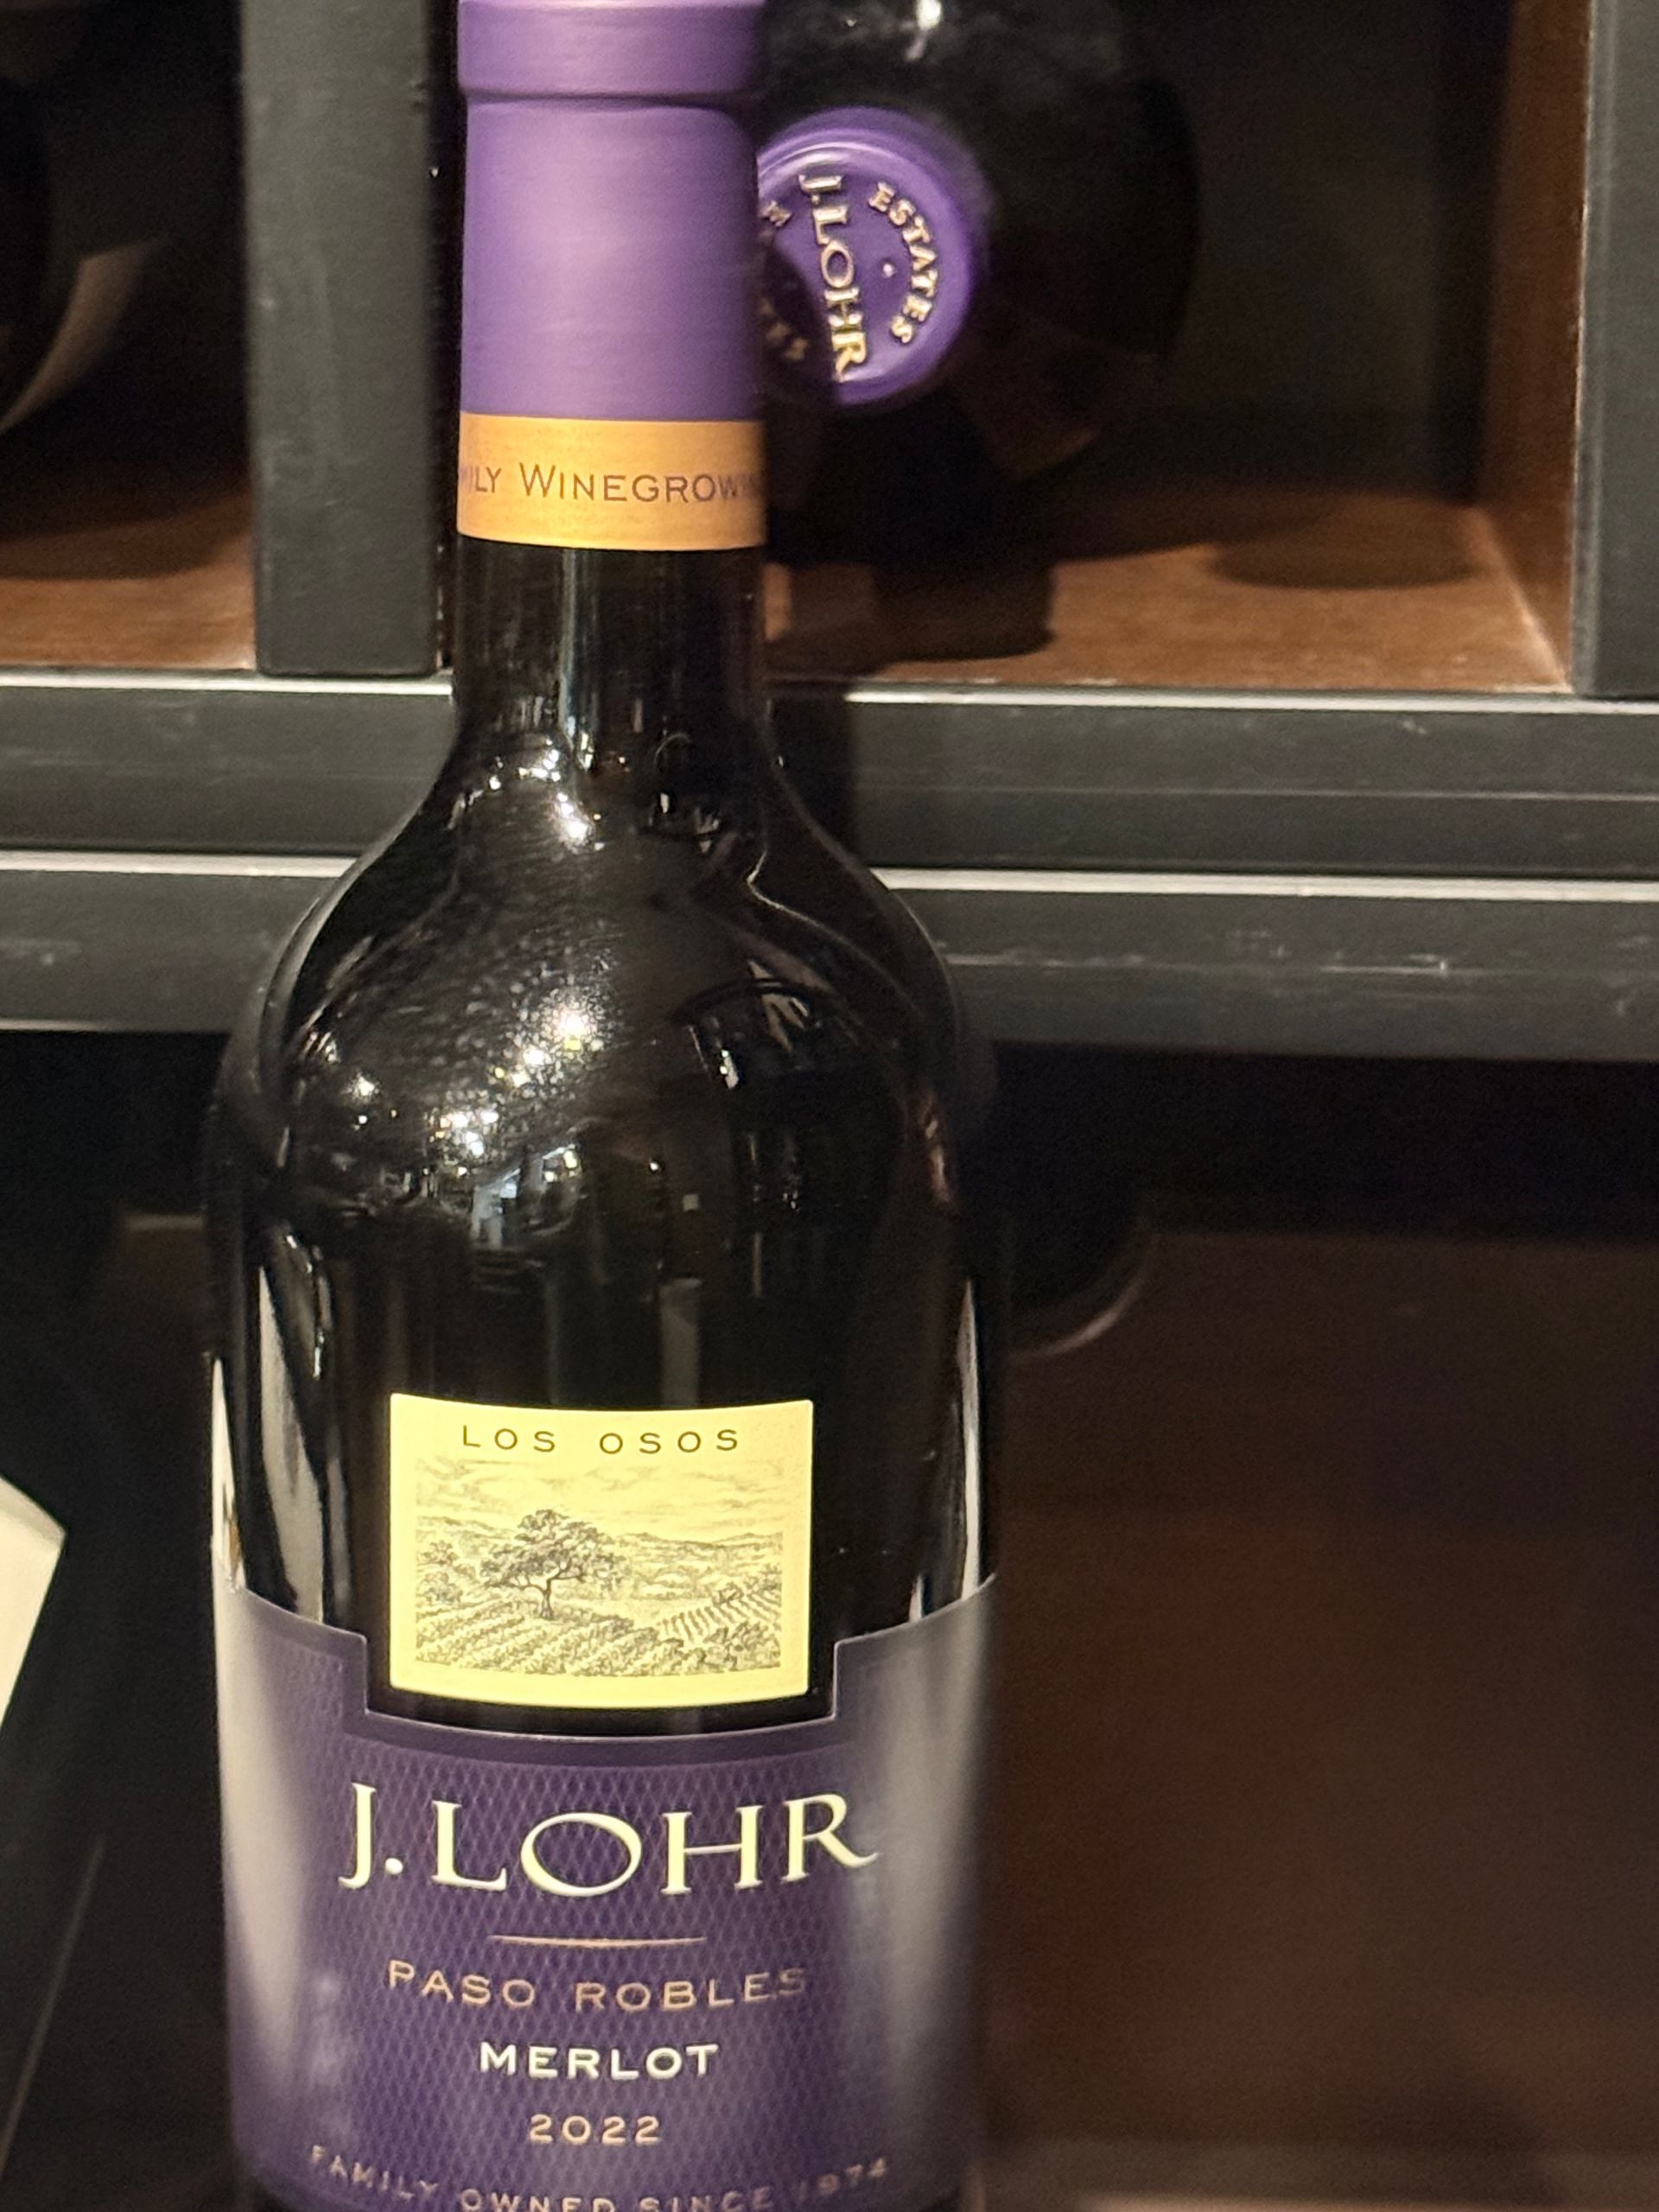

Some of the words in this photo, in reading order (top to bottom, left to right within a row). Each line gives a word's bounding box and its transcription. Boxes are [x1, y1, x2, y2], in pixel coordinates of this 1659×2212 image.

[868, 181, 938, 344] ESTATES
[518, 462, 757, 503] WINEGROW
[462, 1425, 556, 1453] LOS
[599, 1428, 739, 1455] OSOS
[388, 1959, 537, 2008] PASO
[575, 1967, 808, 2013] ROBLES
[479, 2041, 720, 2081] MERLOT
[528, 2113, 661, 2145] 2022
[312, 2144, 439, 2199] FAMILY
[460, 2188, 615, 2212] OWNED
[638, 2185, 774, 2212] SINCE
